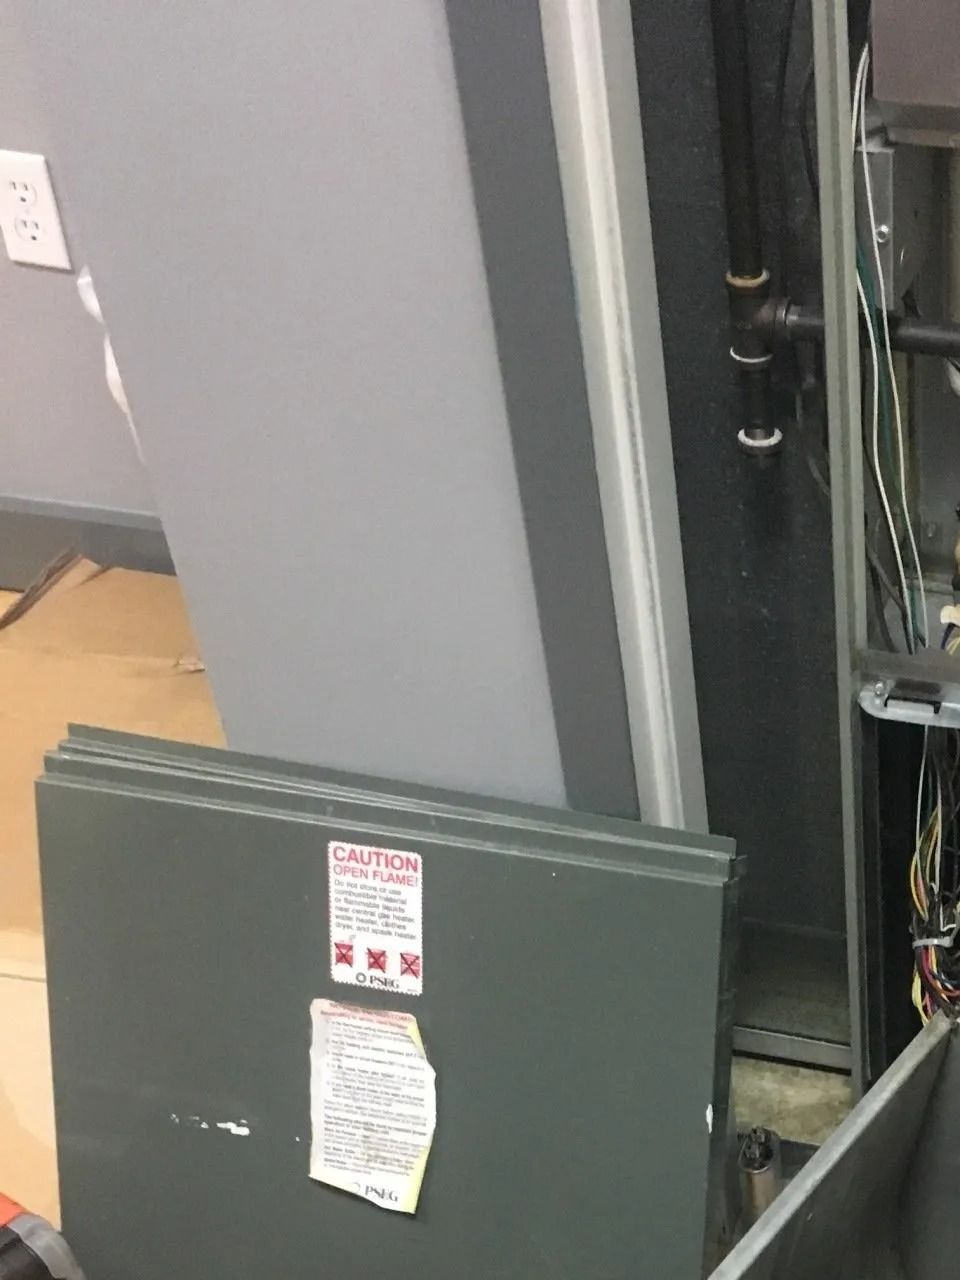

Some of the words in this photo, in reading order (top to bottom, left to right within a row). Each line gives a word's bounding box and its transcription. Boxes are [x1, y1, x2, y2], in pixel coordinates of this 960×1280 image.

[333, 846, 418, 873] CAUTION
[333, 864, 368, 879] OPEN
[373, 870, 418, 887] FLAME!
[334, 879, 344, 887] Do
[369, 975, 400, 989] PSEG
